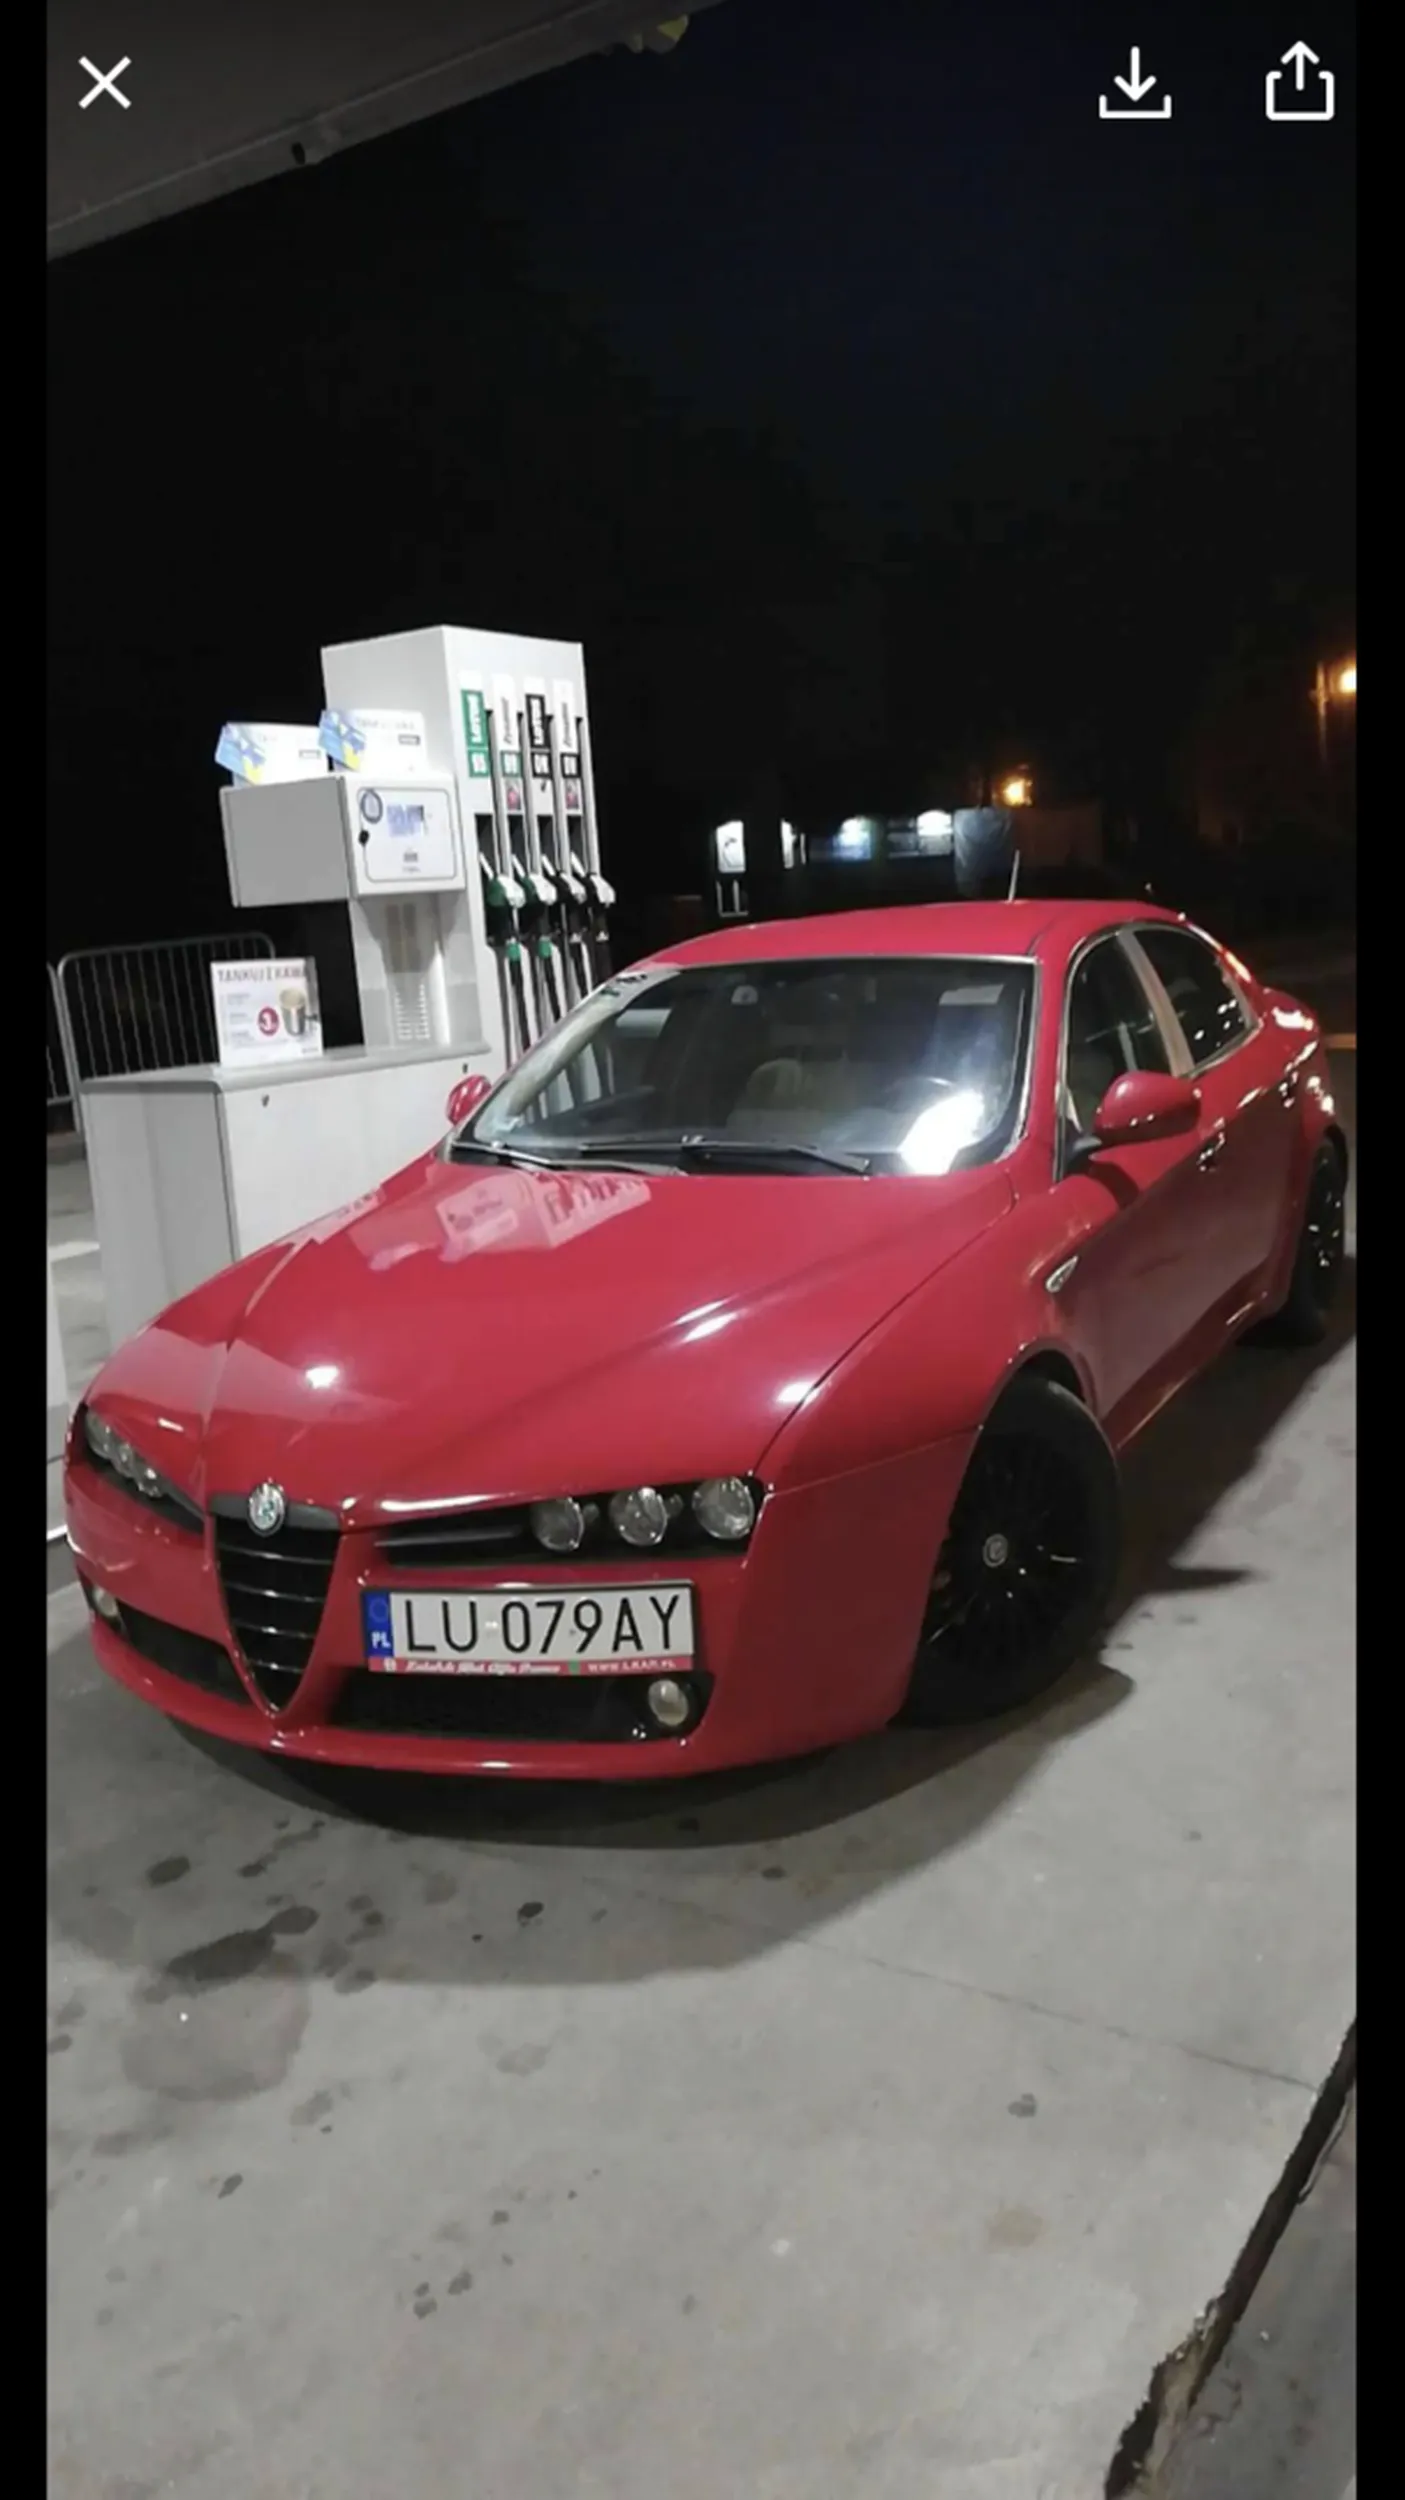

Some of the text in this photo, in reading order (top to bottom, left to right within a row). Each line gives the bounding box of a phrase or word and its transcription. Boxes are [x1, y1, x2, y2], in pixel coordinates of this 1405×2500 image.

[371, 1631, 391, 1648] PL
[405, 1595, 679, 1654] LU 079AY
